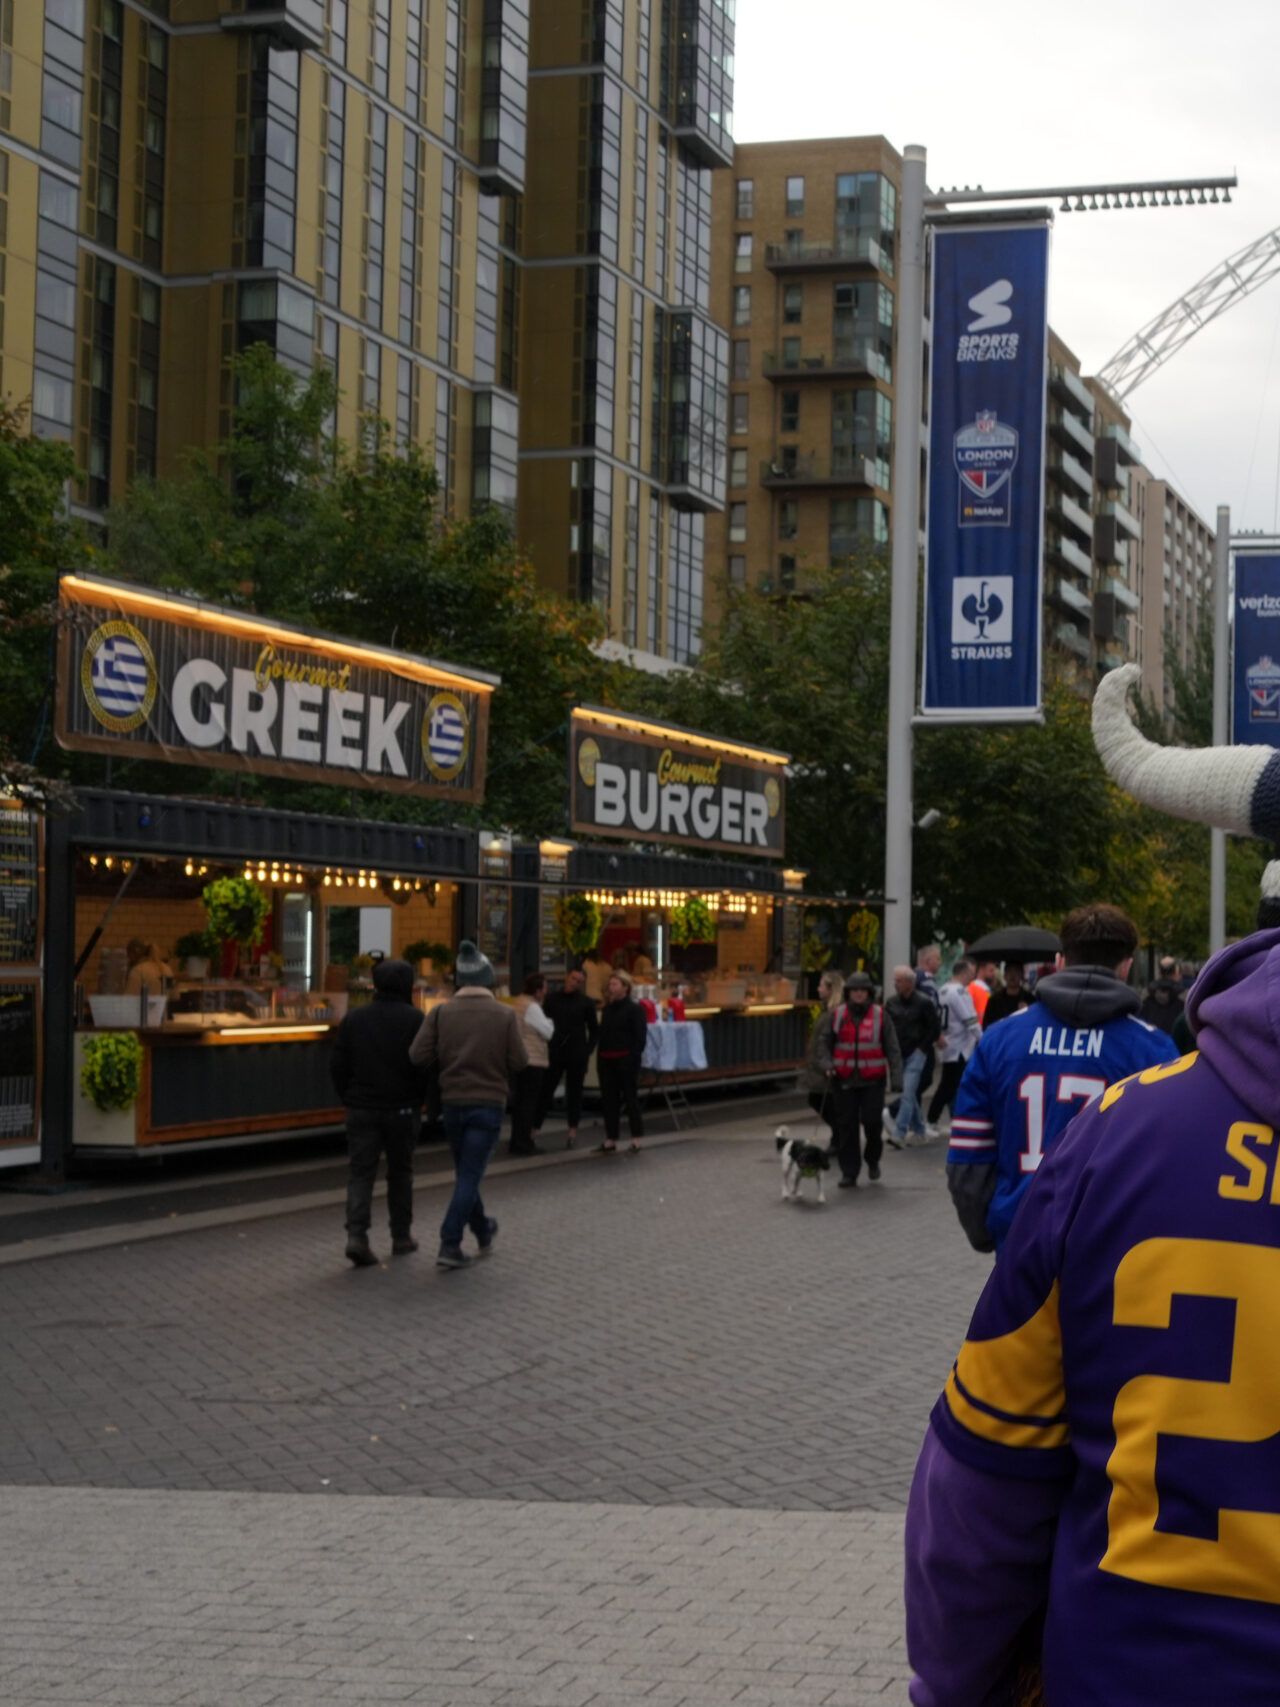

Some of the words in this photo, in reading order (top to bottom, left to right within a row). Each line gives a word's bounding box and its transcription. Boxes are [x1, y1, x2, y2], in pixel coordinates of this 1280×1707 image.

[958, 333, 1019, 349] SPORTS
[956, 347, 1017, 362] BREAKS
[957, 448, 1013, 462] LONDON
[973, 507, 1004, 517] NetApp
[951, 645, 1012, 660] STRAUSS
[255, 645, 350, 693] Gourmet
[171, 657, 411, 777] GREEK
[595, 762, 768, 846] BURGER
[1029, 1026, 1104, 1057] ALLEN
